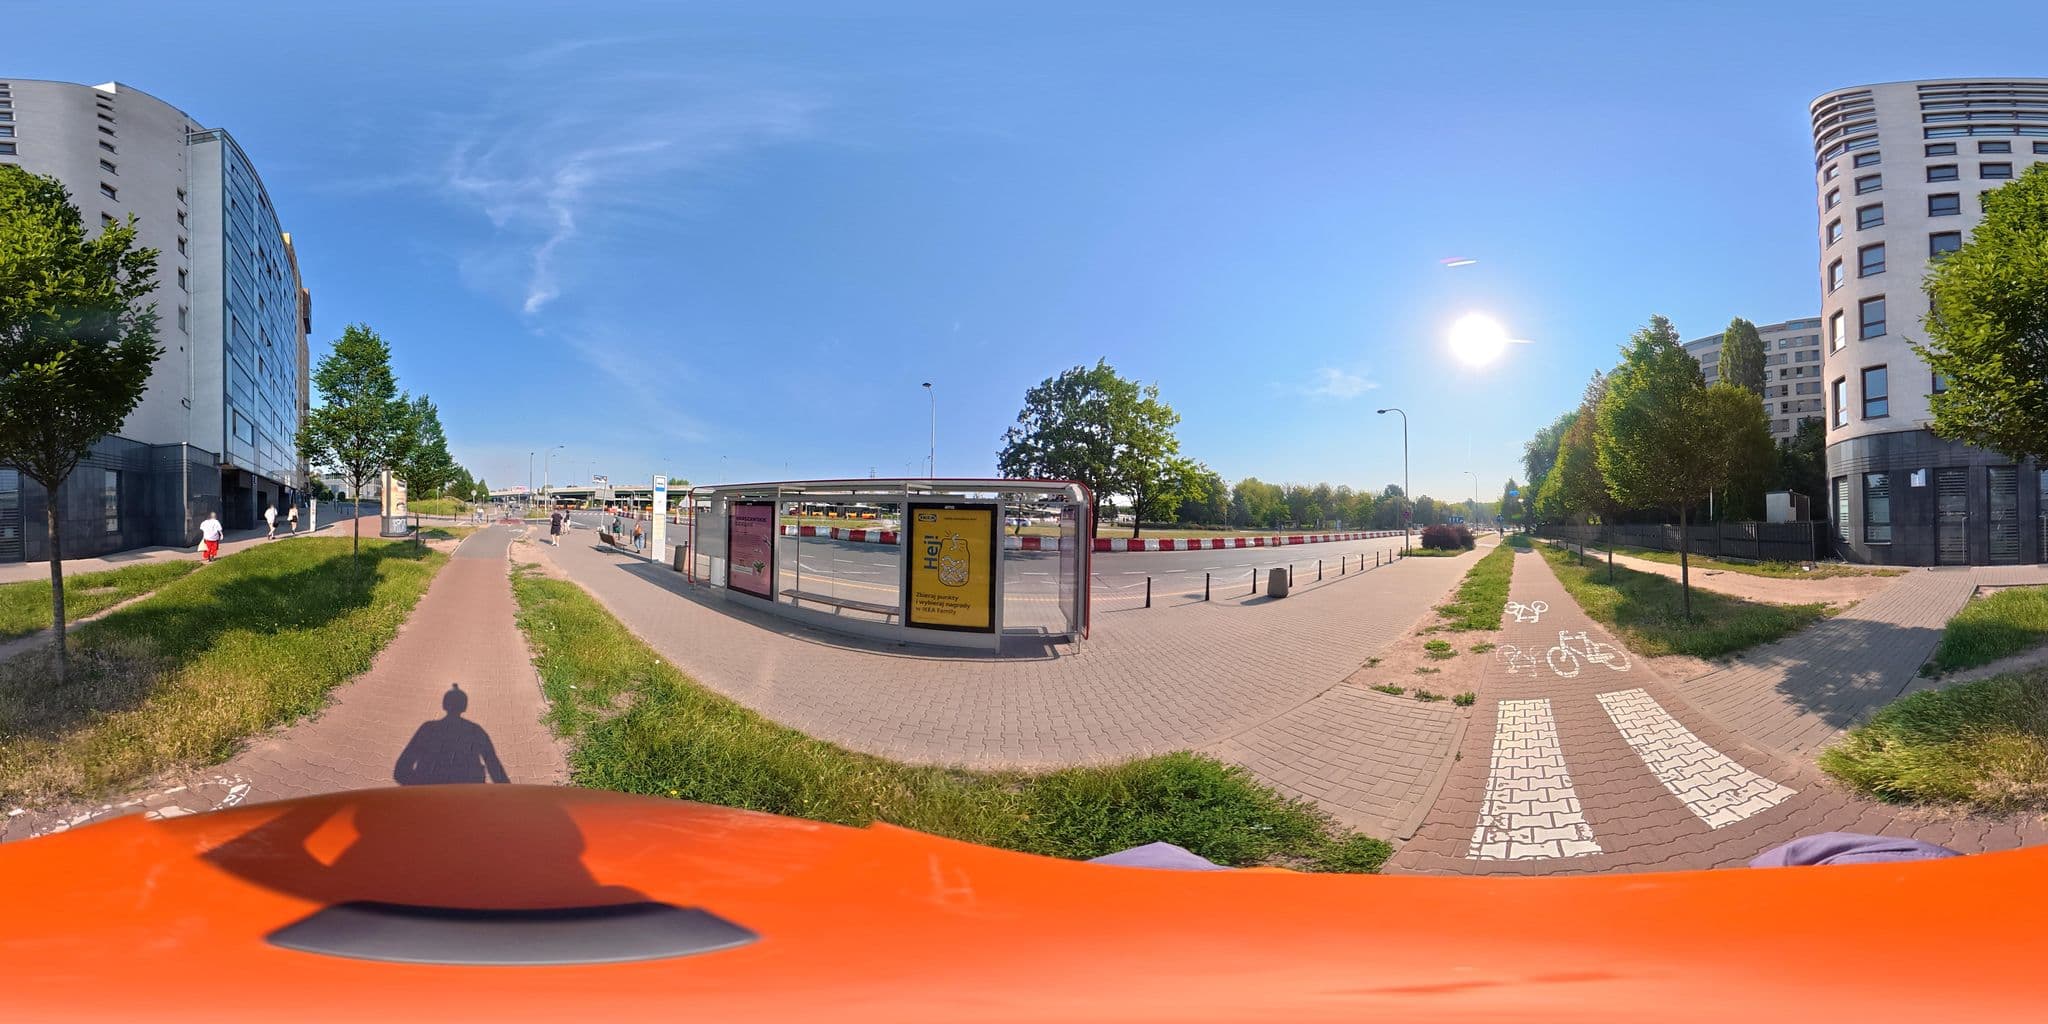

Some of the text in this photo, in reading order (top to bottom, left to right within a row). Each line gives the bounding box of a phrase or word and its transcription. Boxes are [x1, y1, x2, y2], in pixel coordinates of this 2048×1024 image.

[924, 535, 942, 569] Hej!
[916, 592, 960, 602] Zbieraj punkty
[919, 600, 944, 608] wybieraj
[937, 608, 956, 616] Family
